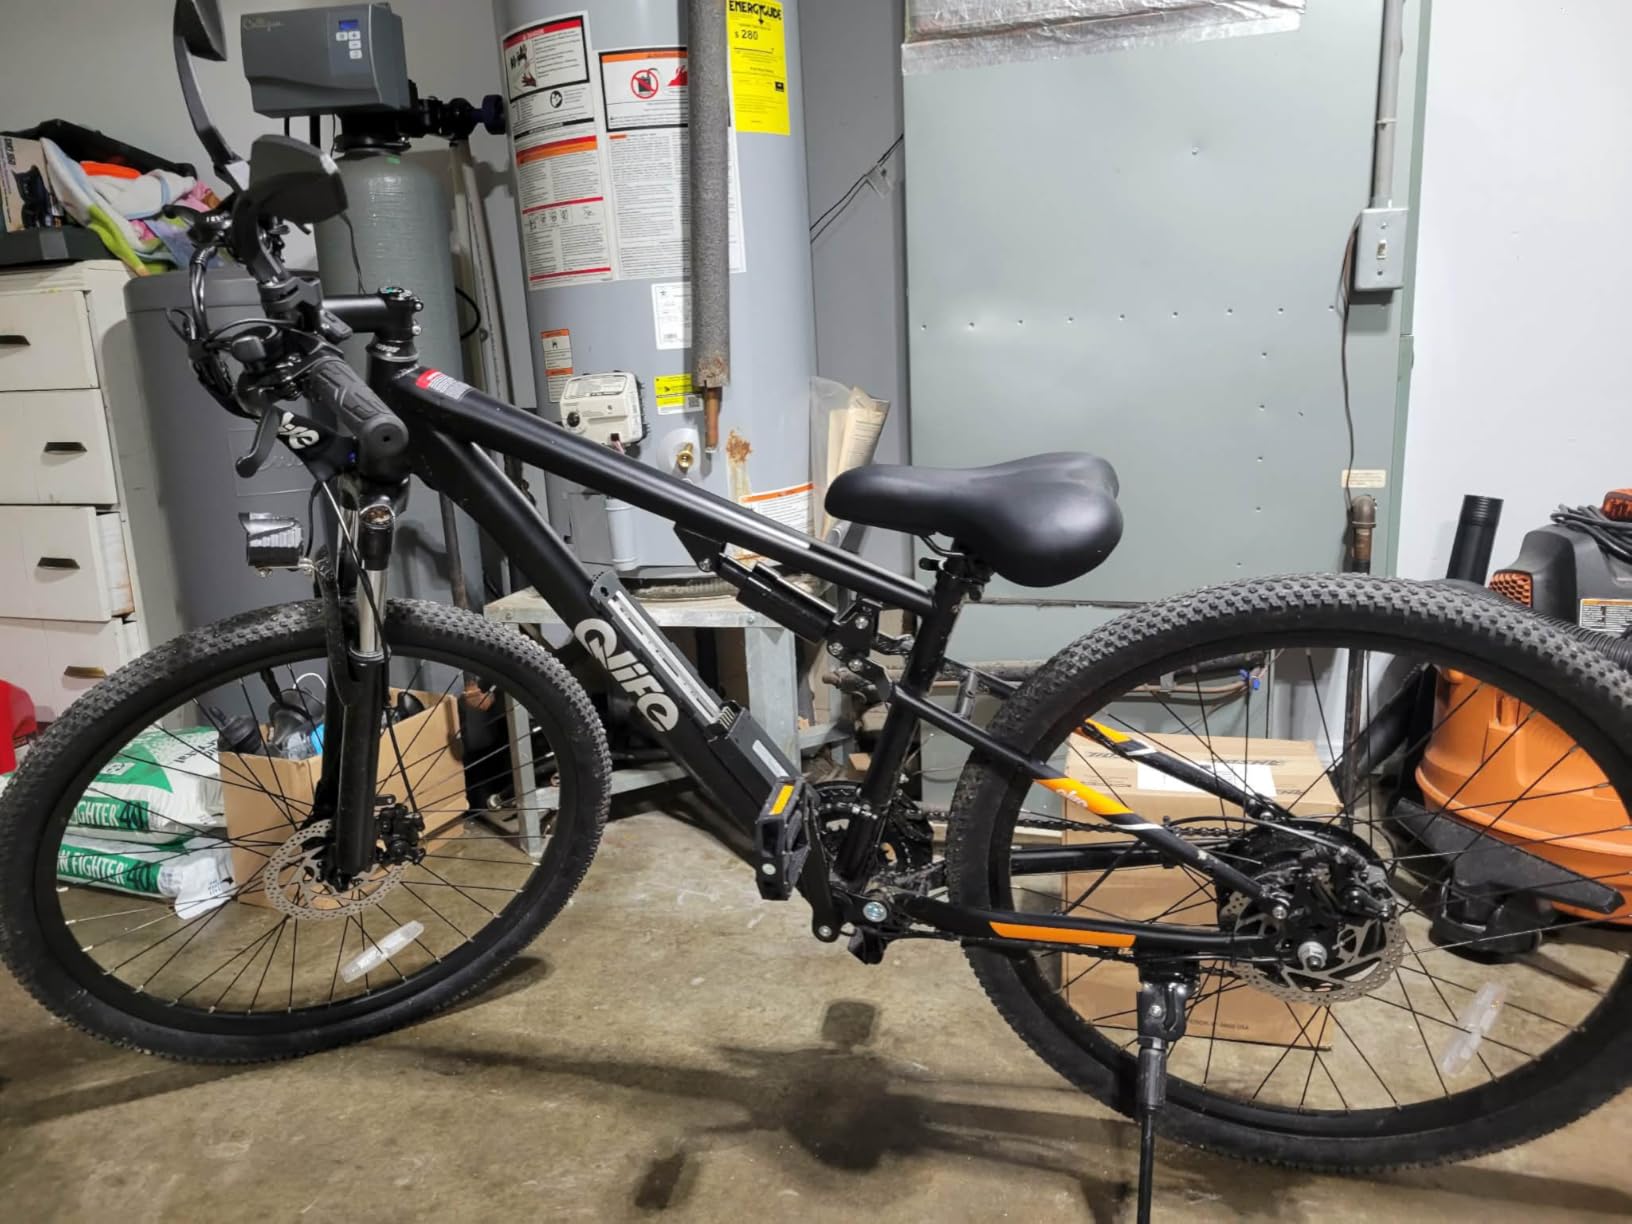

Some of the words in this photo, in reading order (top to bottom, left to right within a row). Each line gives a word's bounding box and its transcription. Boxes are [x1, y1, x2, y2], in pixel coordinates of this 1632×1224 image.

[741, 29, 758, 40] 280
[68, 800, 119, 827] IGHTER
[71, 852, 125, 885] FIGHTER
